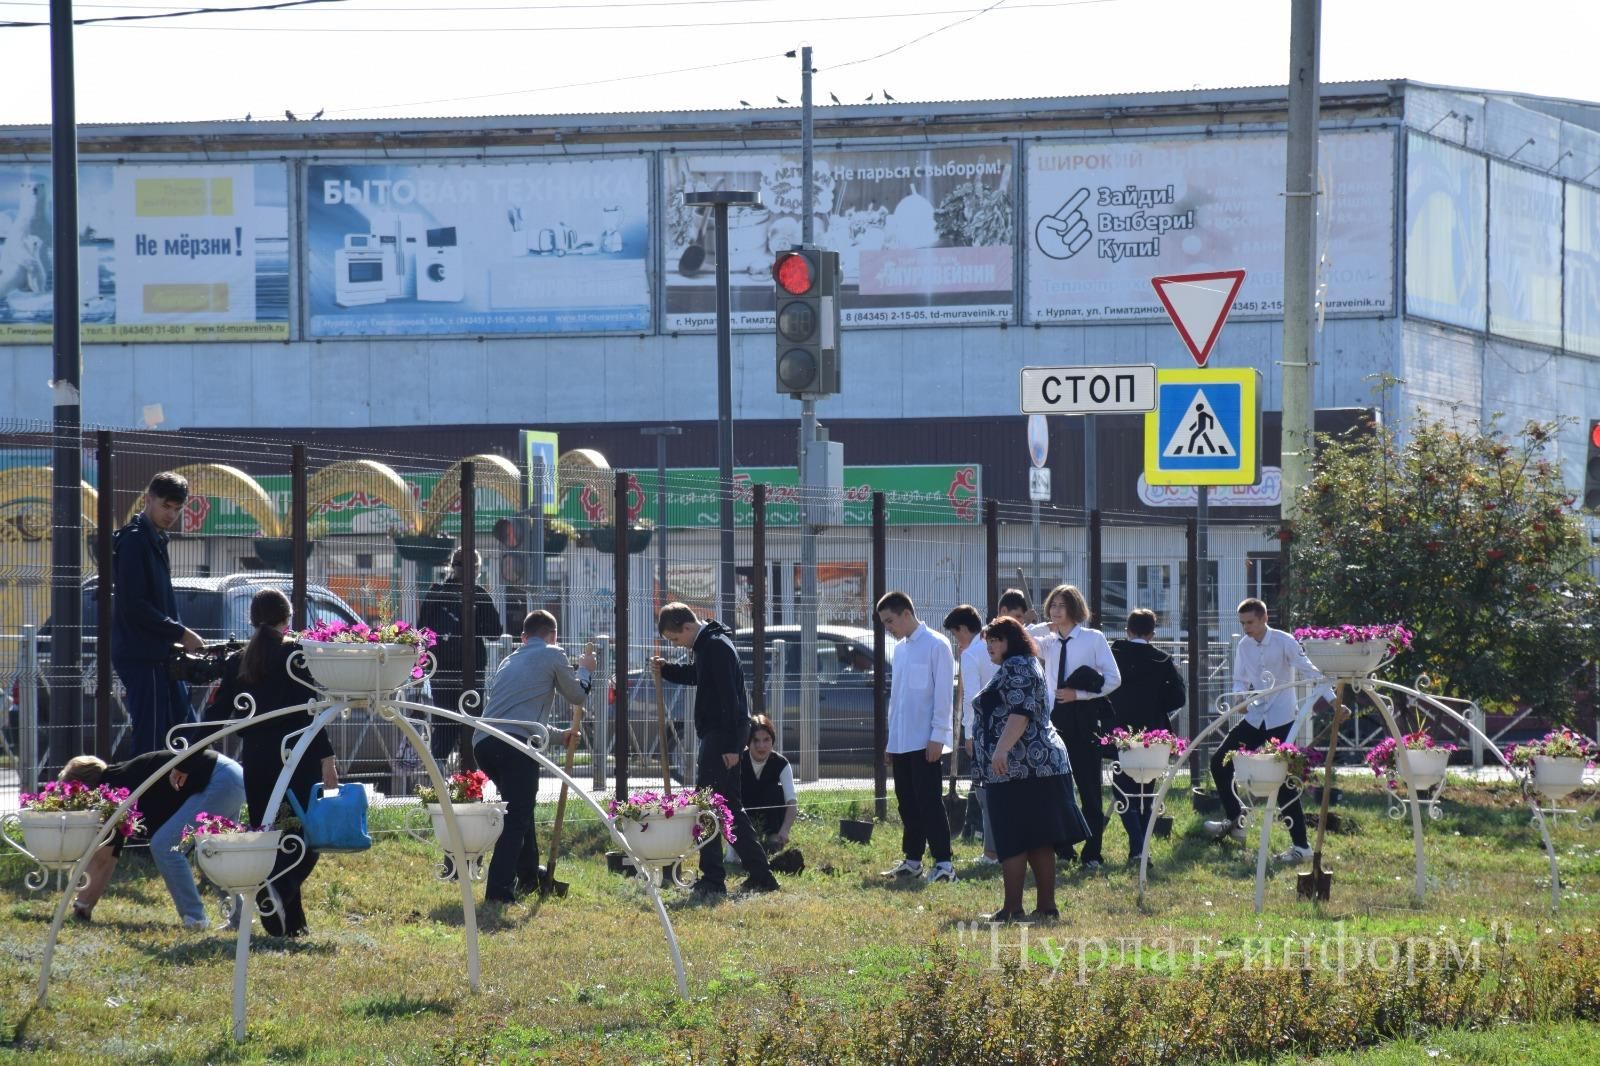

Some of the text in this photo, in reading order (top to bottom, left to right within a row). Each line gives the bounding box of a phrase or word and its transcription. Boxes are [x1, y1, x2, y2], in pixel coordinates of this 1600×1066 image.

[834, 159, 1001, 183] Не парься с выбором!
[1038, 151, 1143, 171] ШИРОКИЙ
[323, 180, 476, 204] БЫТОВАЯ
[1097, 185, 1174, 206] Зайди!
[1097, 210, 1194, 233] Выбери!
[135, 233, 157, 256] Не
[1097, 238, 1160, 263] Купи!
[685, 316, 717, 328] Нурла
[740, 315, 776, 326] Гиматд
[846, 313, 851, 321] 8
[854, 311, 888, 323] (84345)
[931, 307, 1009, 320] td-muraveinik.ru
[1046, 307, 1084, 318] Нурлат,
[1086, 308, 1101, 317] ул.
[1104, 305, 1165, 314] Гиматдинов
[1232, 301, 1258, 311] 4345)
[1326, 297, 1386, 308] uraveinik.ru
[1041, 374, 1135, 405] СТОП
